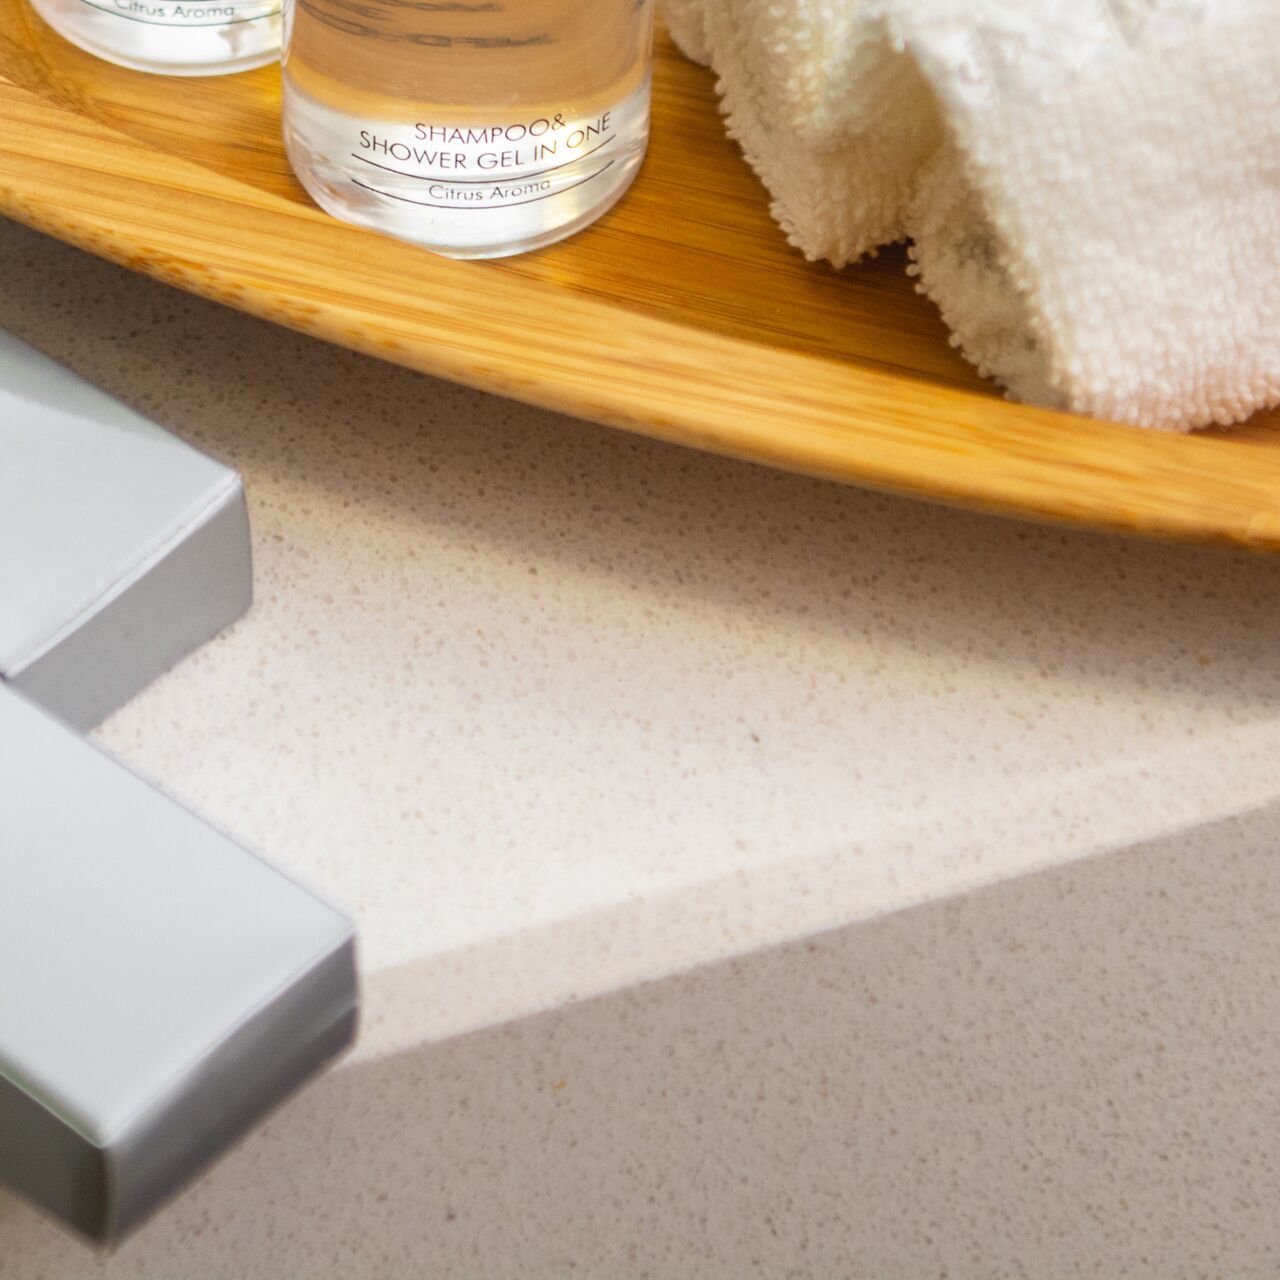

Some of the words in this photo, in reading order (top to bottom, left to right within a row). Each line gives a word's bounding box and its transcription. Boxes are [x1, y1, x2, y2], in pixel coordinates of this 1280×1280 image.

[172, 5, 236, 19] Aroma
[359, 130, 467, 170] SHOWER
[477, 150, 525, 170] GEL
[533, 140, 557, 162] IN
[565, 111, 612, 149] ONE
[414, 113, 567, 145] SHAMPOO&
[428, 184, 483, 202] Citrus
[489, 179, 551, 200] Aroma
